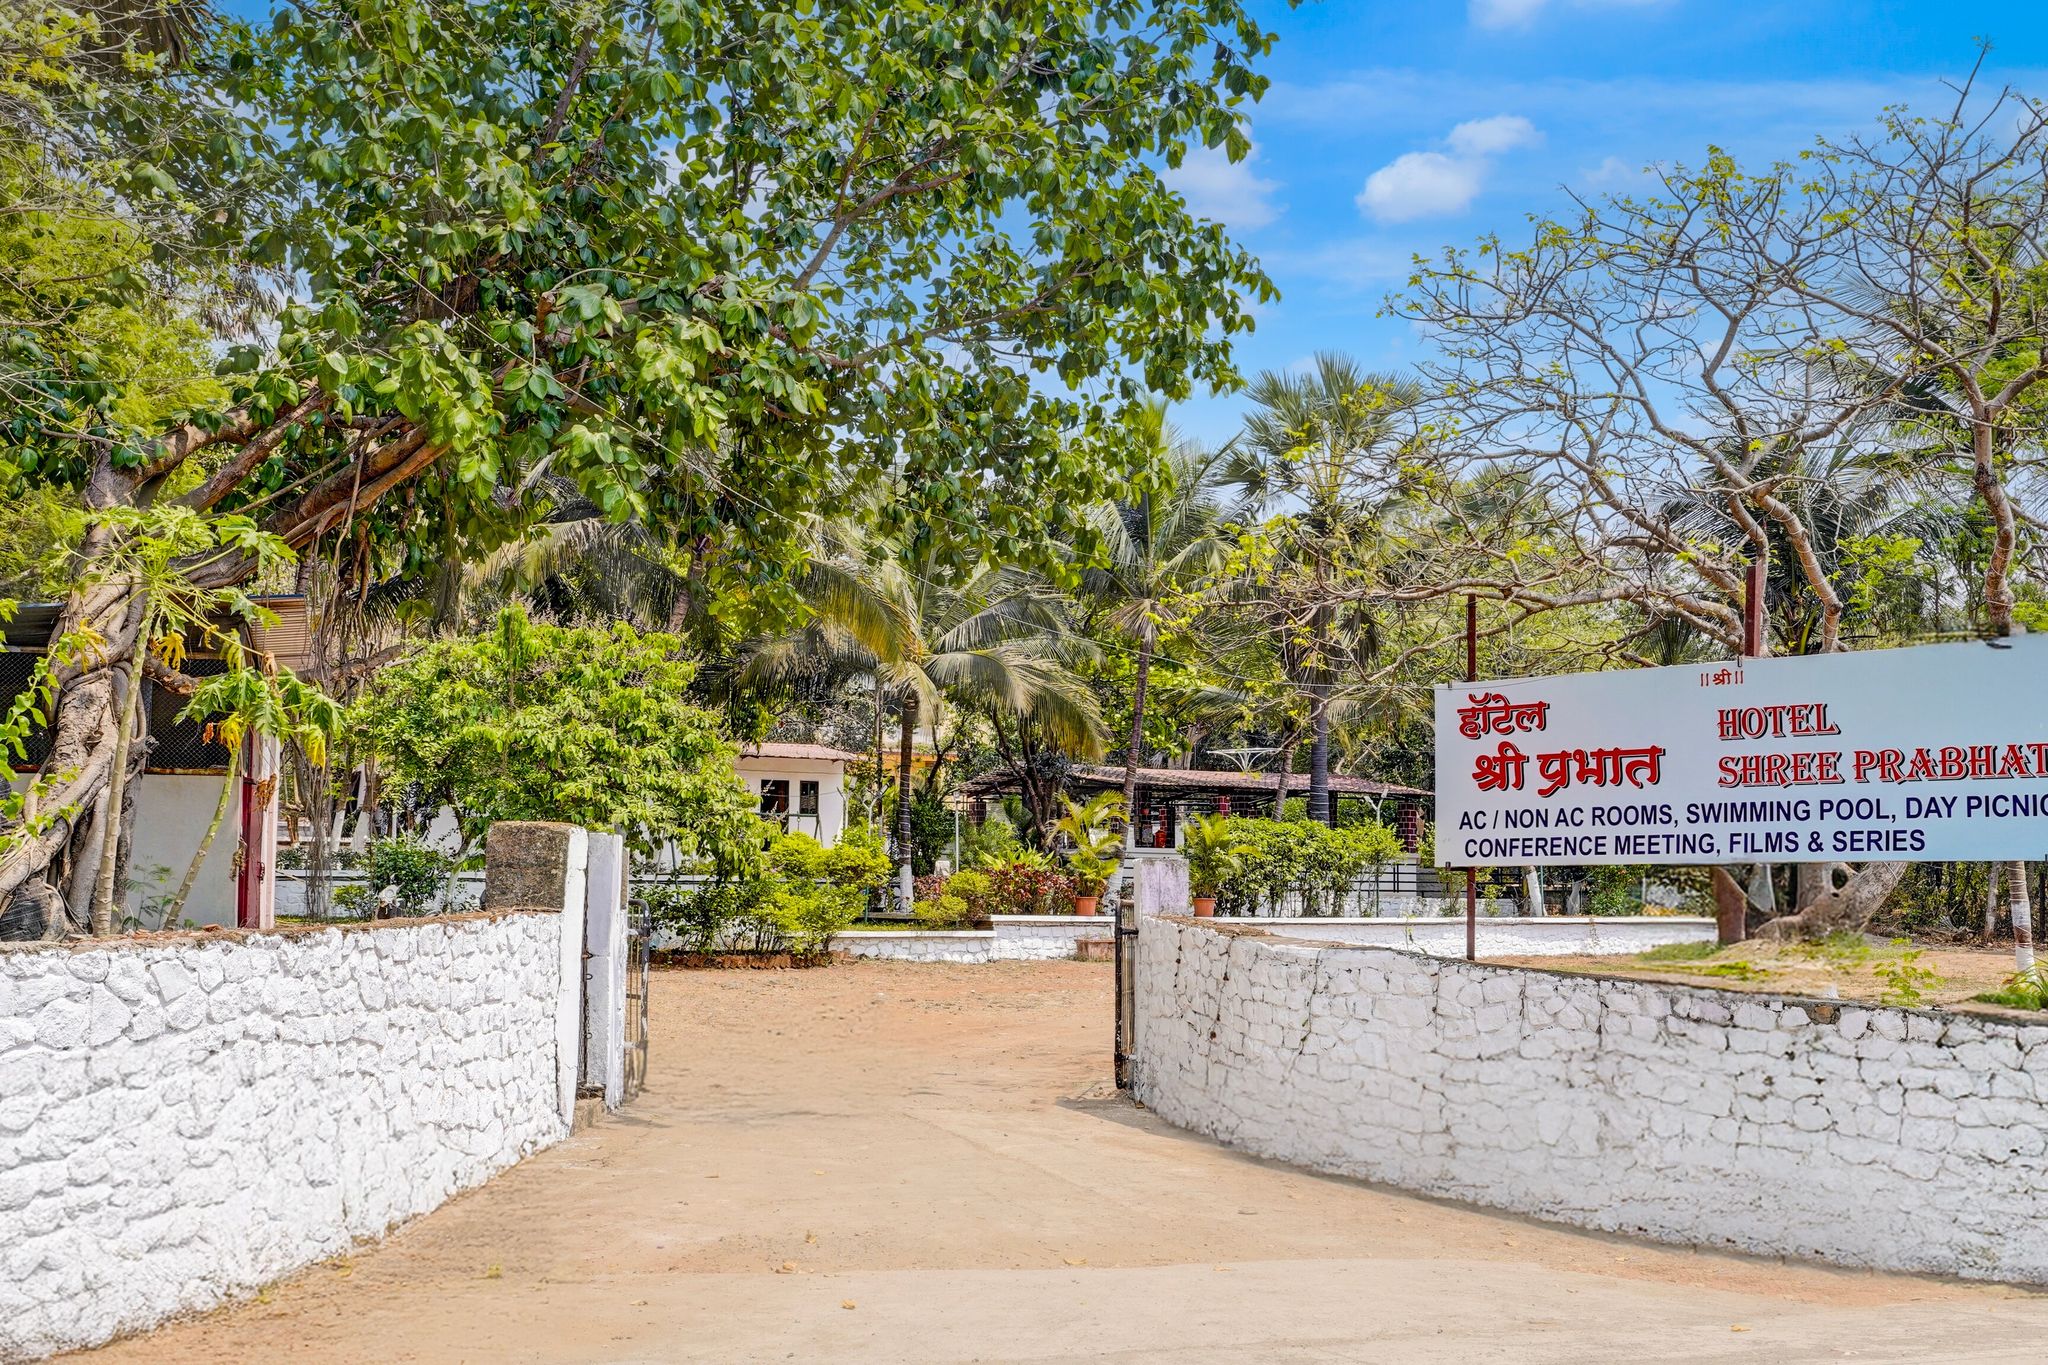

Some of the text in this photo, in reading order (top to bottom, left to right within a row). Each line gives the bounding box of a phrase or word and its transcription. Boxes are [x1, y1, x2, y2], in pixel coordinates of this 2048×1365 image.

[1457, 692, 1550, 739] हॉटेल
[1717, 703, 1841, 740] HOTEL
[1472, 741, 1666, 798] श्री प्रभात
[1717, 743, 2048, 788] SHREE PRABHAT
[1459, 810, 1487, 830] AC
[1505, 808, 1549, 829] NON
[1555, 807, 1584, 827] AC
[1592, 804, 1678, 829] ROOMS,
[1686, 800, 1811, 825] SWIMMING
[1820, 798, 1896, 824] POOL,
[1906, 796, 1958, 819] DAY
[1465, 829, 1926, 858] CONFERENCE MEETING, FILMS & SERIES
